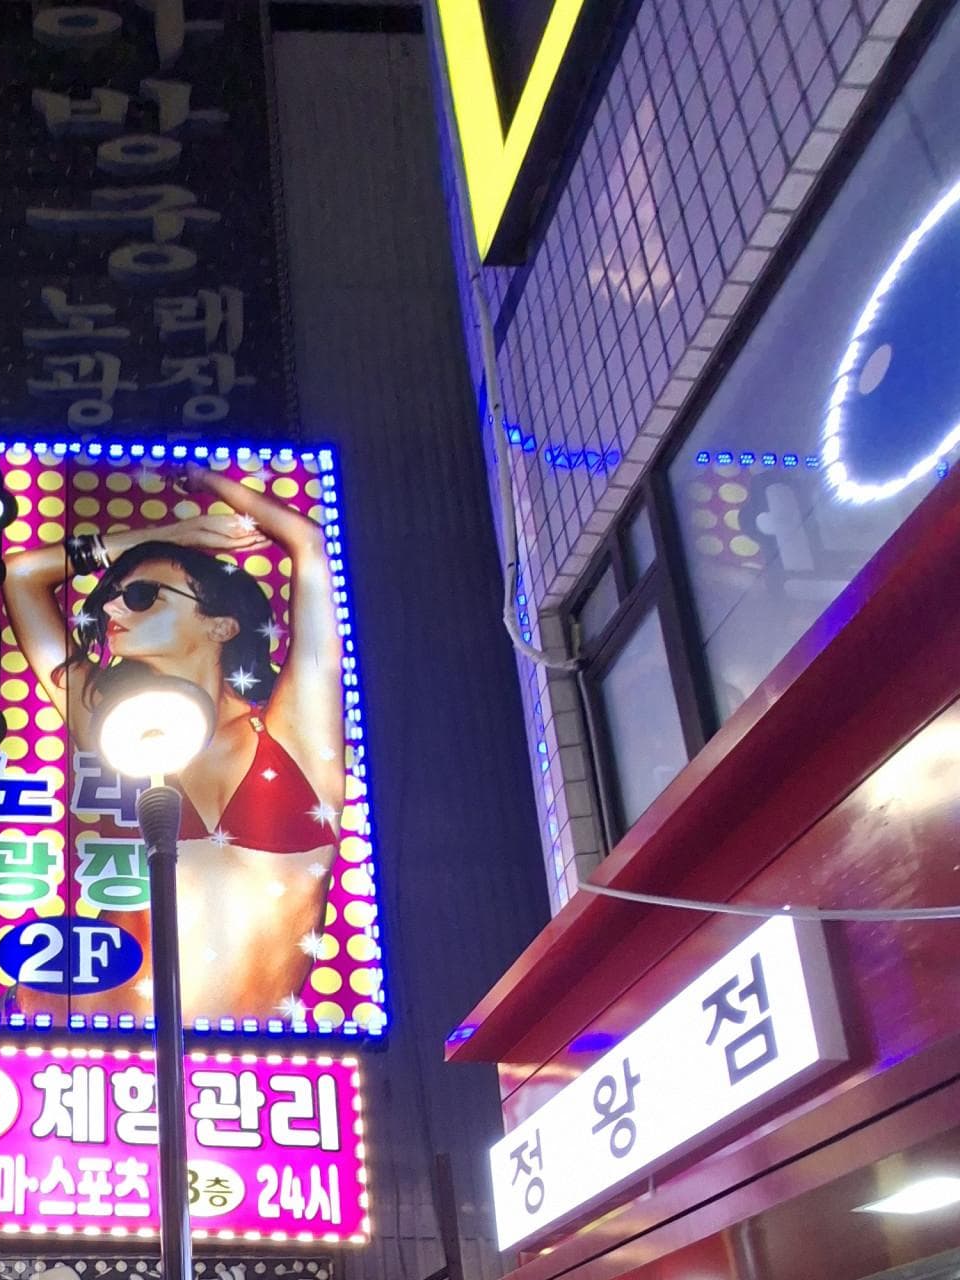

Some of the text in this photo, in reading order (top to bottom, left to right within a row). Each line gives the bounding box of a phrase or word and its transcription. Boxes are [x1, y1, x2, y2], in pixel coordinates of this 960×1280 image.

[23, 286, 244, 353] 노래
[27, 351, 256, 432] 광장
[18, 922, 122, 987] 2F
[510, 952, 779, 1214] 정왕점
[256, 1163, 342, 1225] 24시
